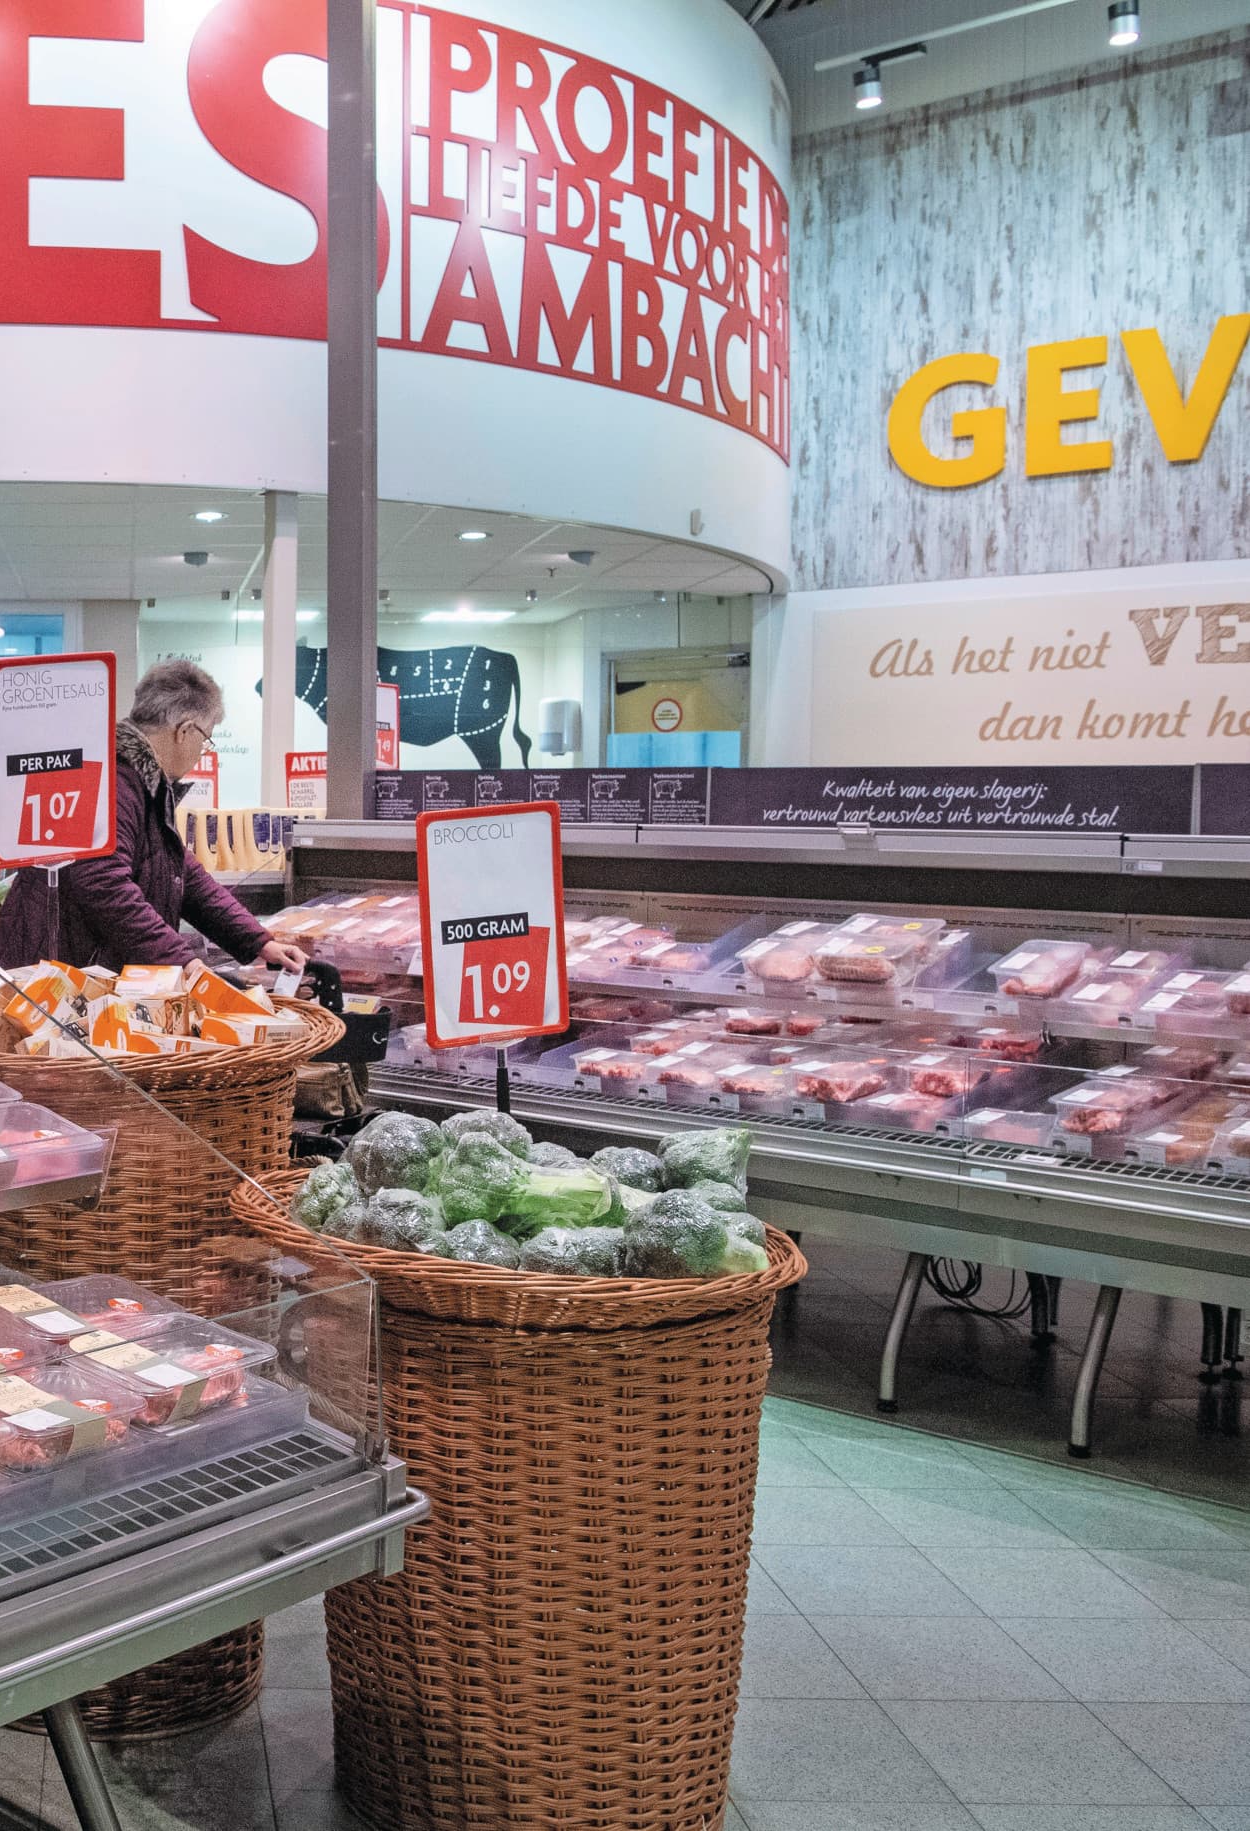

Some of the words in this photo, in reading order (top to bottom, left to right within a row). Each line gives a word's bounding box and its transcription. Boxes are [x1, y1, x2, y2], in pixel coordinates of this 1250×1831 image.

[429, 132, 626, 256] LIEFDE
[421, 220, 788, 456] AMBACHT
[888, 312, 1250, 490] GEV
[869, 637, 935, 679] Als
[951, 634, 1015, 675] het
[1027, 628, 1112, 671] niet
[1128, 602, 1250, 667] VE
[413, 666, 422, 676] 5
[484, 659, 491, 670] 1
[444, 659, 453, 669] 2
[2, 670, 53, 689] HONIG
[482, 680, 491, 691] 3
[2, 681, 106, 705] GROENTESAUS
[482, 698, 490, 709] 6
[978, 700, 1064, 743] dan
[1076, 697, 1193, 740] komt
[18, 757, 44, 772] PER
[46, 753, 72, 770] PAK
[822, 777, 897, 799] Kwaliteit
[900, 783, 931, 798] van
[932, 781, 979, 809] eigen
[979, 777, 1049, 810] slagerij:
[25, 790, 81, 842] 1.07
[763, 801, 844, 823] vertrouwd
[844, 804, 943, 824] varkensvlees
[947, 805, 973, 824] uit
[977, 803, 1075, 825] vertrouwde
[1077, 805, 1120, 828] stal.
[433, 823, 514, 846] BROCCOLI
[446, 923, 473, 942] 500
[477, 917, 525, 937] GRAM
[464, 960, 531, 1020] 1.09
